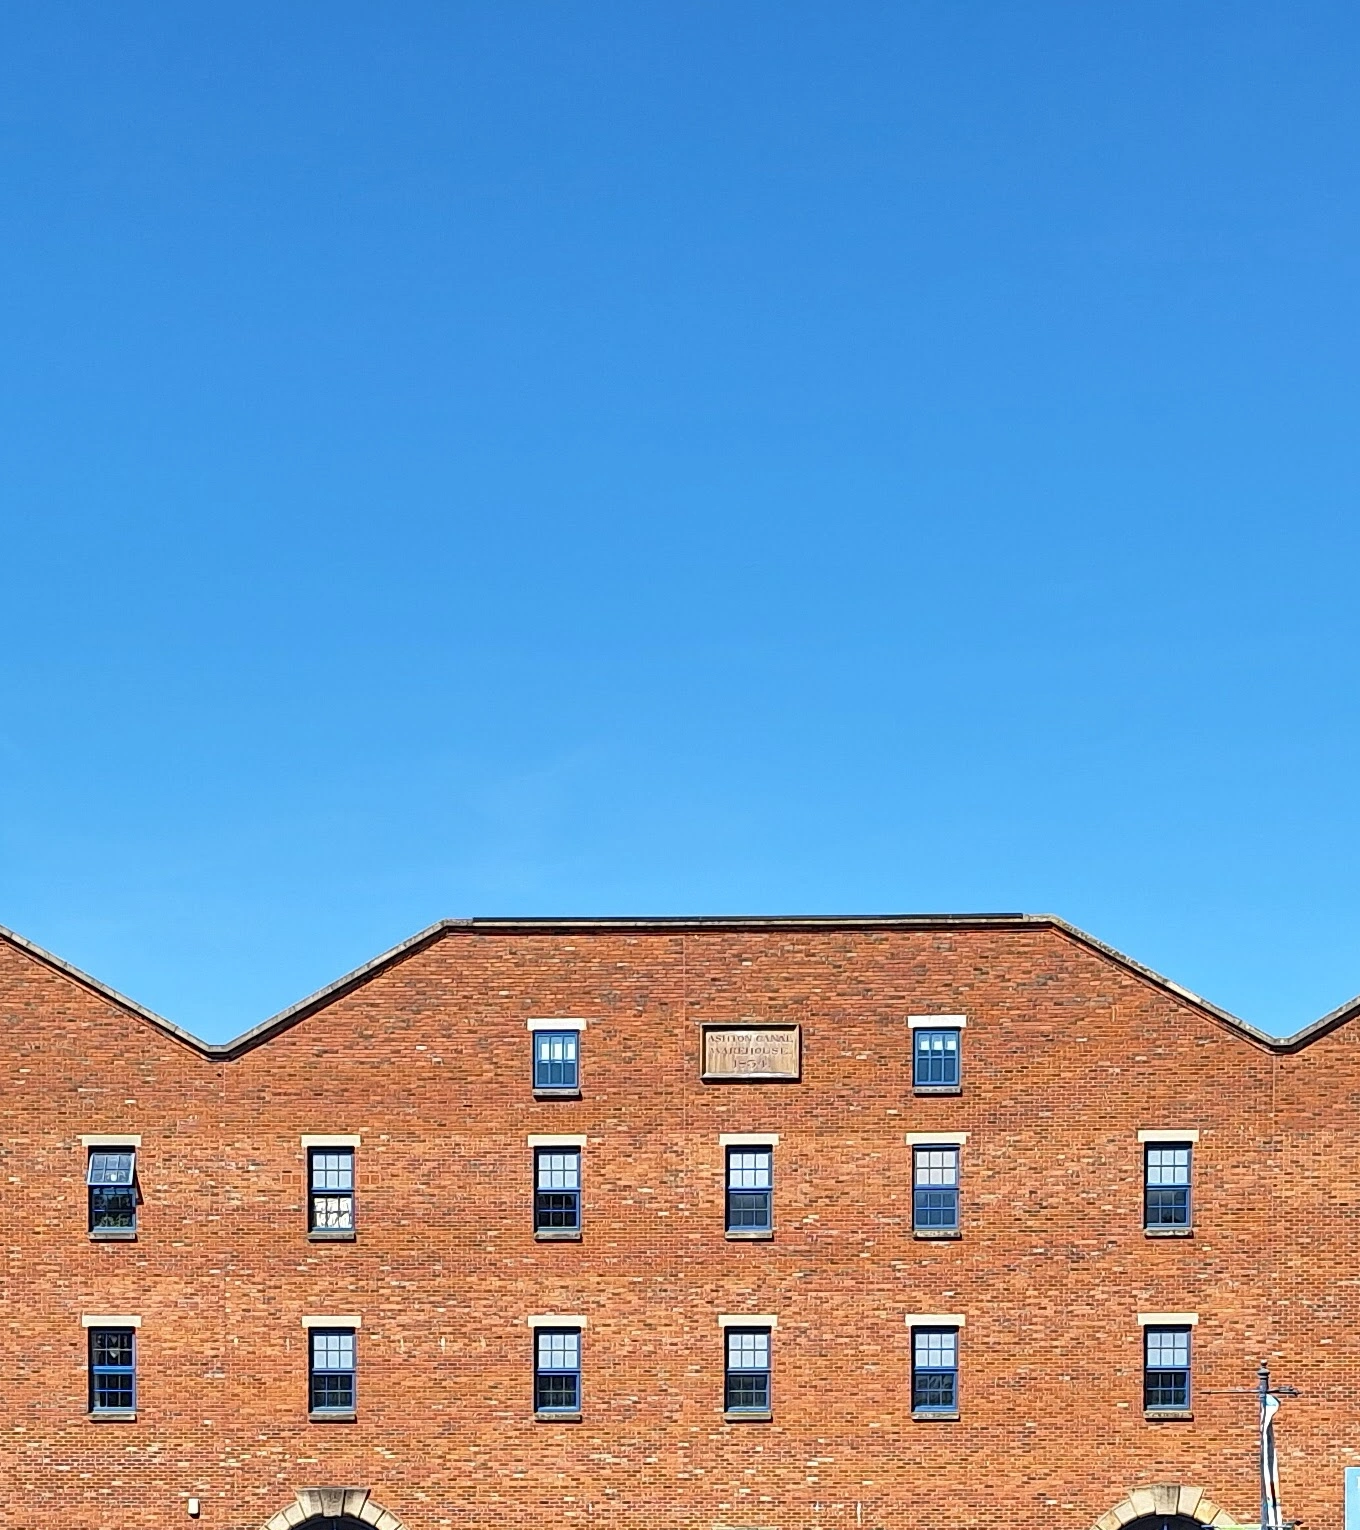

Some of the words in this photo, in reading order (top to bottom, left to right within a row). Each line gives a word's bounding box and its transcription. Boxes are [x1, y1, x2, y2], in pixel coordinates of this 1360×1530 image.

[708, 1034, 752, 1043] ASHTON
[755, 1034, 793, 1043] CANAL
[709, 1047, 789, 1055] WAREHOUSE
